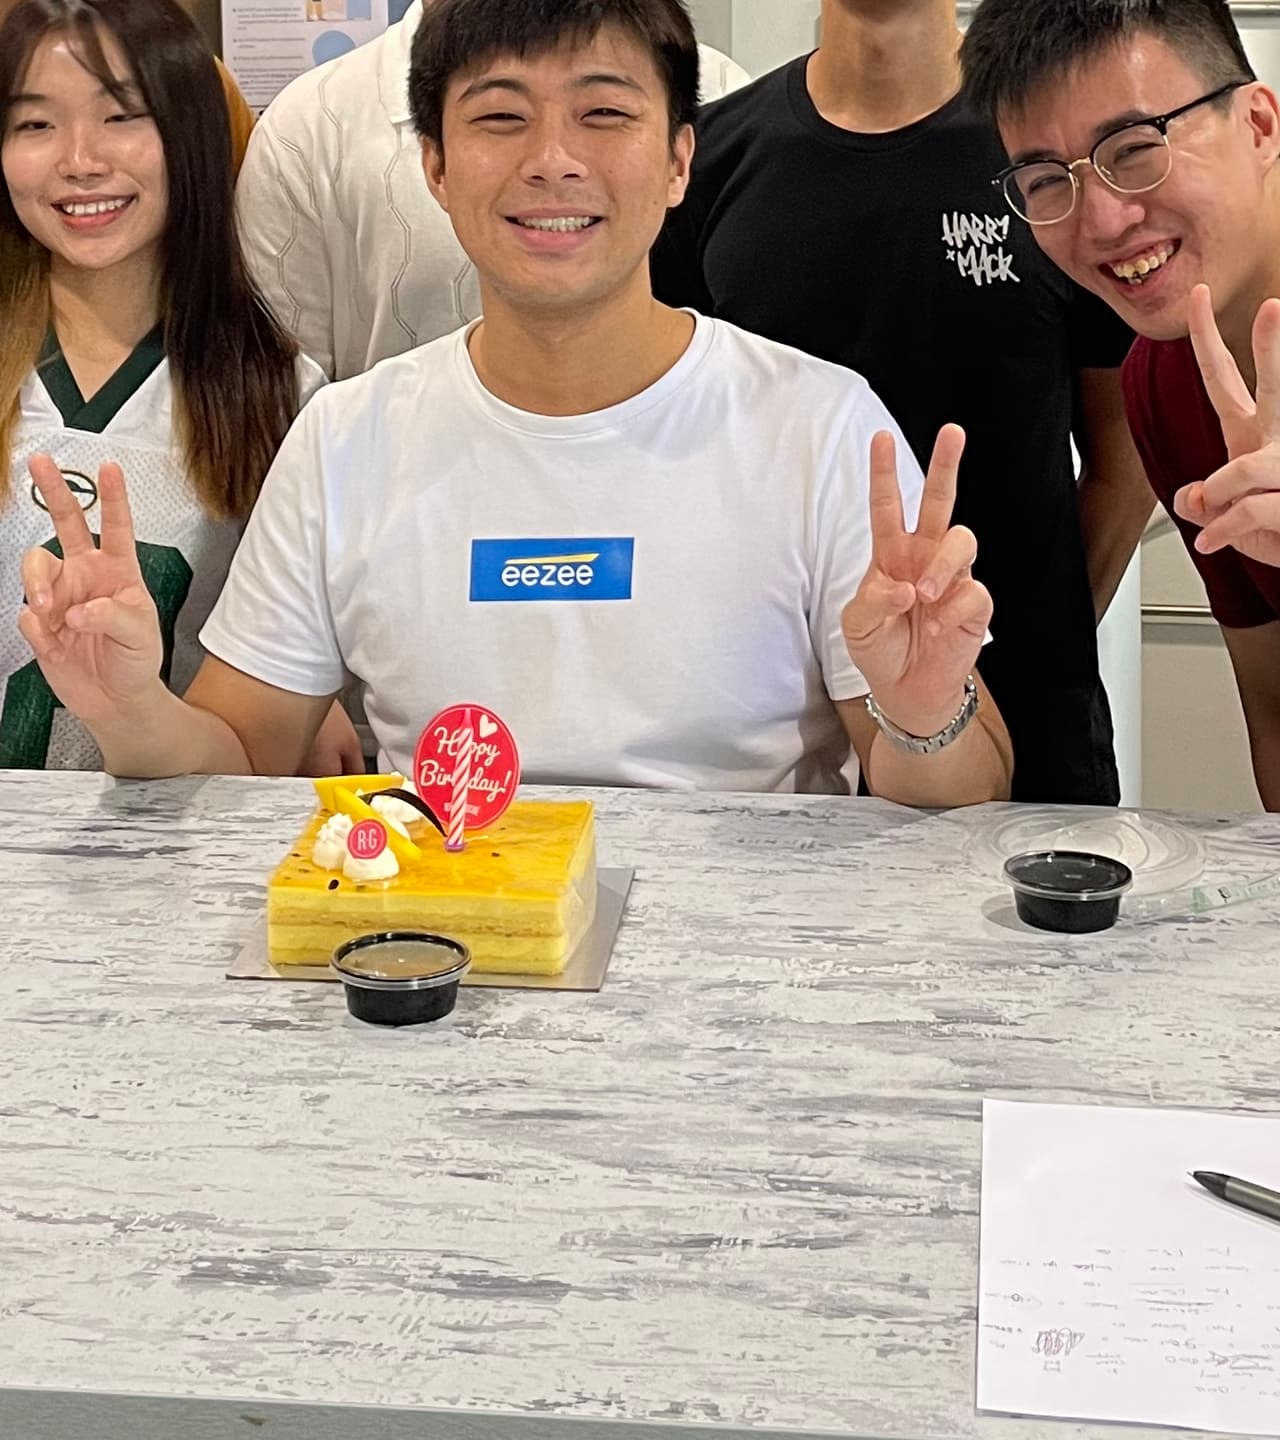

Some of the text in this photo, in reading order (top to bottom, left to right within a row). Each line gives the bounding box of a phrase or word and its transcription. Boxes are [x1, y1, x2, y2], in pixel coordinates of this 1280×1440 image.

[501, 564, 594, 587] eezee
[433, 726, 501, 767] Hppy
[420, 759, 513, 803] Birday!
